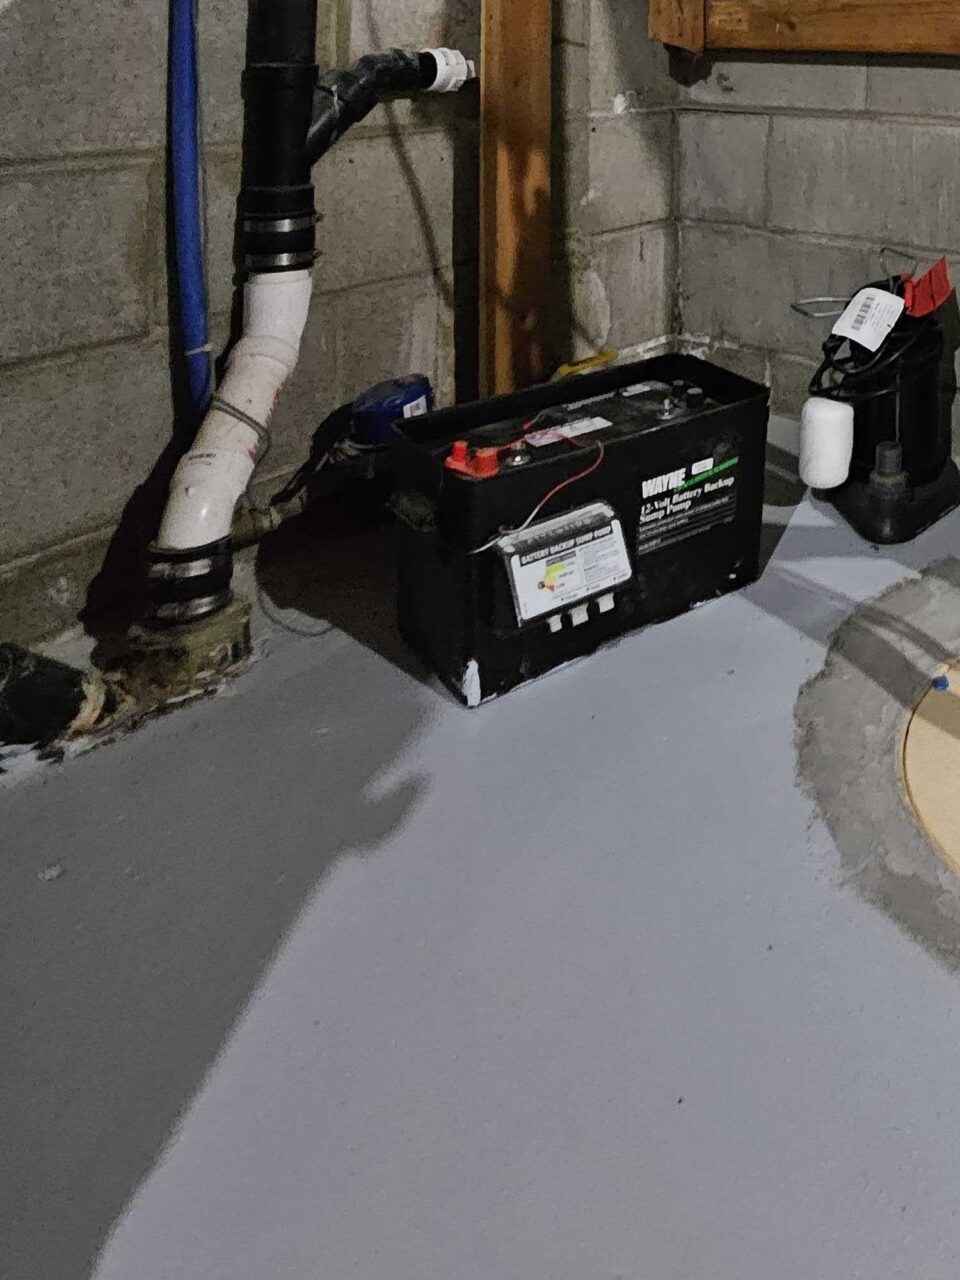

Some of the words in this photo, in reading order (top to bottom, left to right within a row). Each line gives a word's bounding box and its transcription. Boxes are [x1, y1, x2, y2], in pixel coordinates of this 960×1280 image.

[642, 468, 686, 499] WAYNE
[672, 488, 703, 504] Battery
[704, 477, 735, 493] Backup
[640, 510, 665, 524] Sump
[666, 501, 692, 515] Pump
[521, 548, 549, 565] BATTERY
[550, 539, 575, 555] BACKUP
